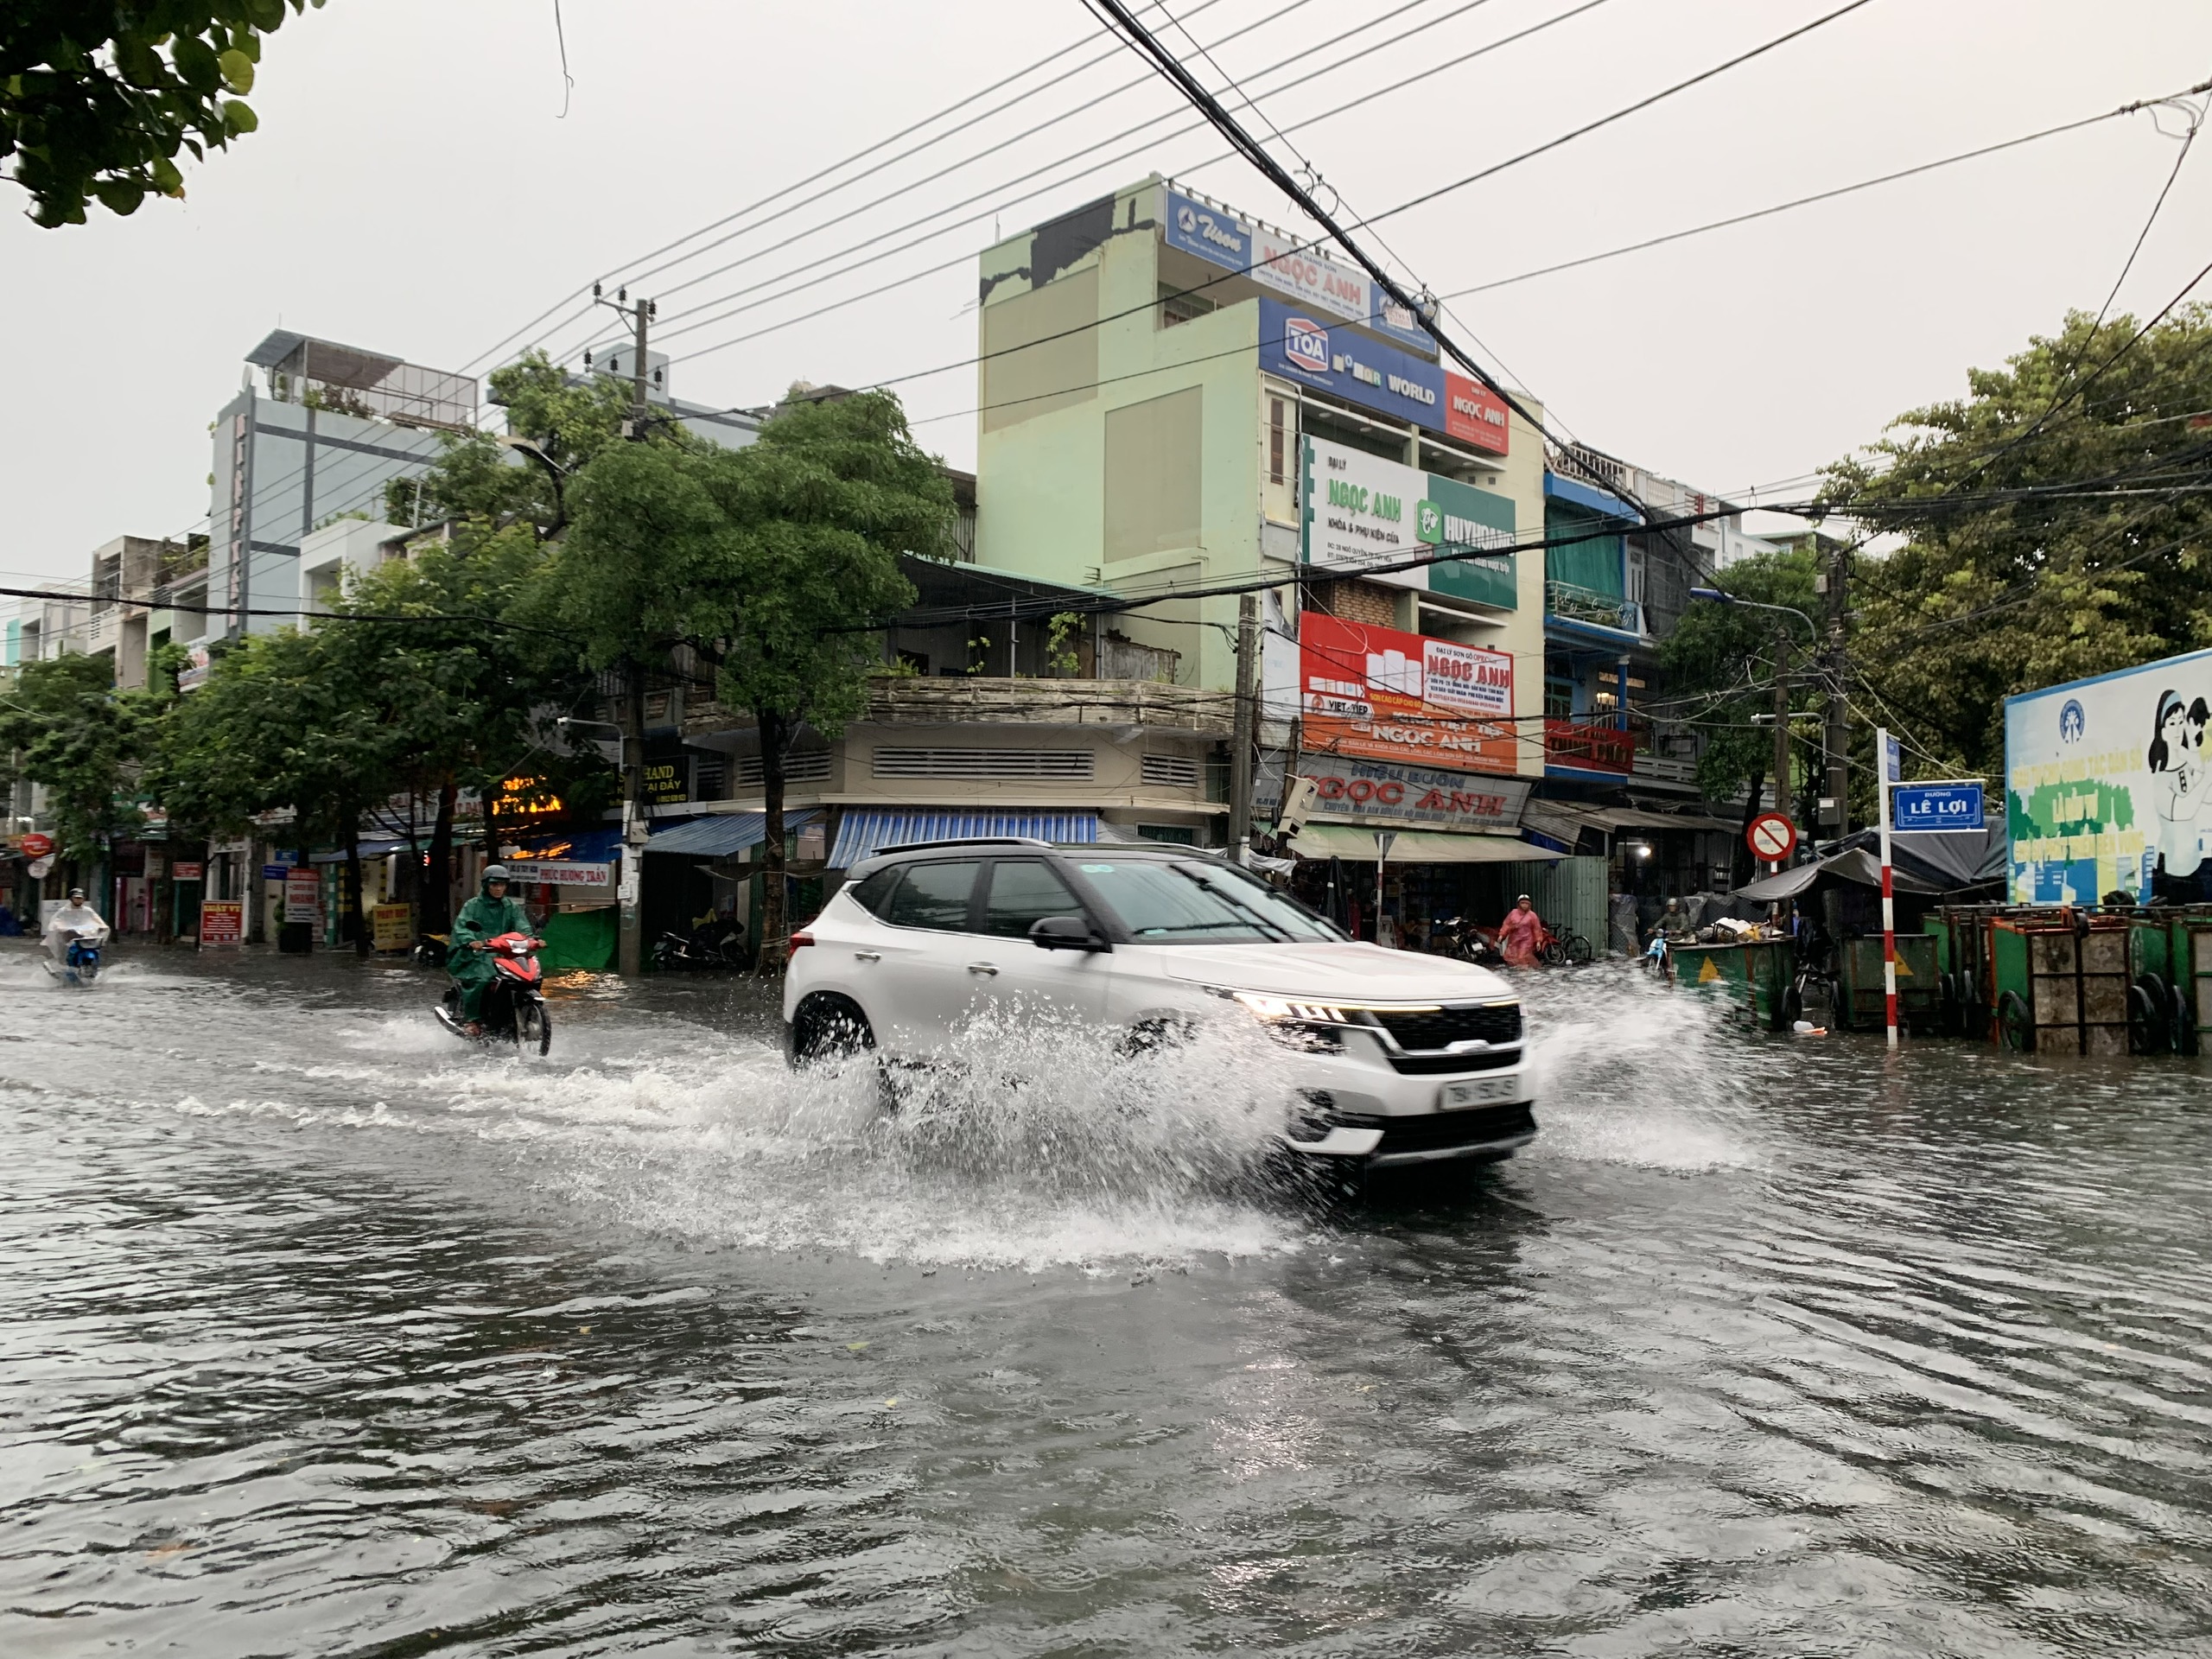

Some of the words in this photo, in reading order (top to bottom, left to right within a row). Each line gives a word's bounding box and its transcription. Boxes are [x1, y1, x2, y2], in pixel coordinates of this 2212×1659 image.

[1263, 245, 1318, 285] NGỌC
[1323, 272, 1362, 306] ANH
[1291, 329, 1325, 361] TOA
[1388, 373, 1435, 405] WORLD
[1453, 394, 1483, 420] NGỌC
[1484, 406, 1505, 428] ANH
[1328, 454, 1338, 470] ĐẠI
[1338, 457, 1346, 470] LÝ
[1328, 478, 1369, 517] NGỌC
[1372, 491, 1402, 524] ANH
[1328, 517, 1346, 531] KHÓA
[1349, 522, 1354, 533] &
[1355, 524, 1370, 538] PHỤ
[1370, 527, 1385, 542] KIỆN
[1386, 531, 1400, 544] CỬA
[1436, 646, 1446, 655] ĐẠI
[1453, 650, 1465, 658] SƠN
[1427, 654, 1472, 681] NGỌC
[1476, 664, 1510, 688] ANH
[1370, 693, 1381, 702] SƠN
[1382, 695, 1392, 703] CAO
[1392, 696, 1403, 705] CẤP
[1372, 724, 1434, 748] NGỌC
[1439, 734, 1481, 753] ANH
[659, 779, 682, 791] ĐÂY
[1351, 764, 1404, 781] HIỆU
[1408, 771, 1466, 789] BUÔN
[1299, 774, 1406, 805] GỌC
[1415, 788, 1508, 817] ANH
[1910, 799, 1932, 814] LÊ
[1938, 798, 1967, 815] LỢI
